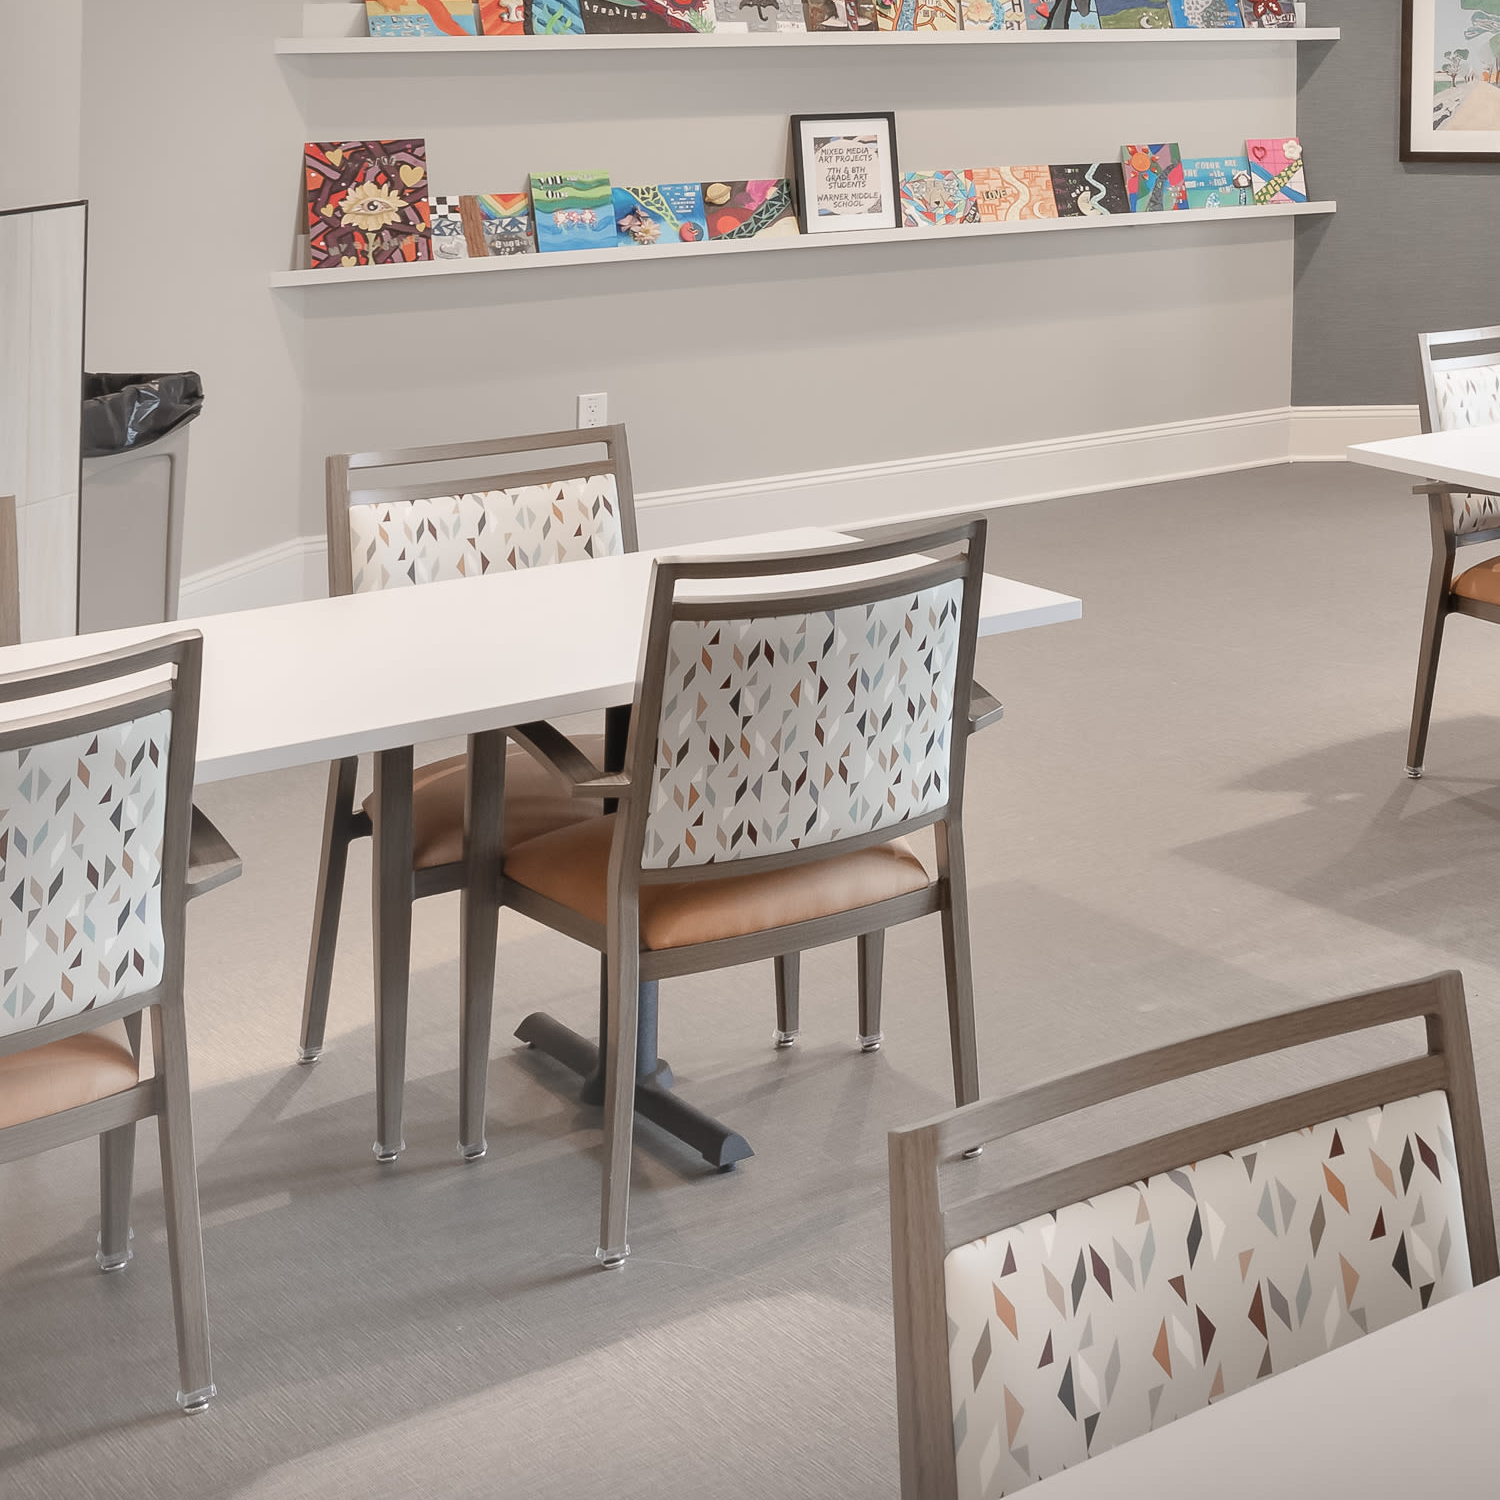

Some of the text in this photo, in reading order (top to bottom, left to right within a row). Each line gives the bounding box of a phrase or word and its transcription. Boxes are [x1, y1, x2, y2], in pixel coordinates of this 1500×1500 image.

[818, 154, 872, 163] ART PROJECTS
[827, 167, 841, 175] 7TH
[826, 174, 850, 182] GRADE
[828, 181, 866, 189] STUDENTS
[817, 193, 850, 202] WARNER
[983, 189, 1007, 200] LOVE
[833, 200, 864, 208] SCHOOL
